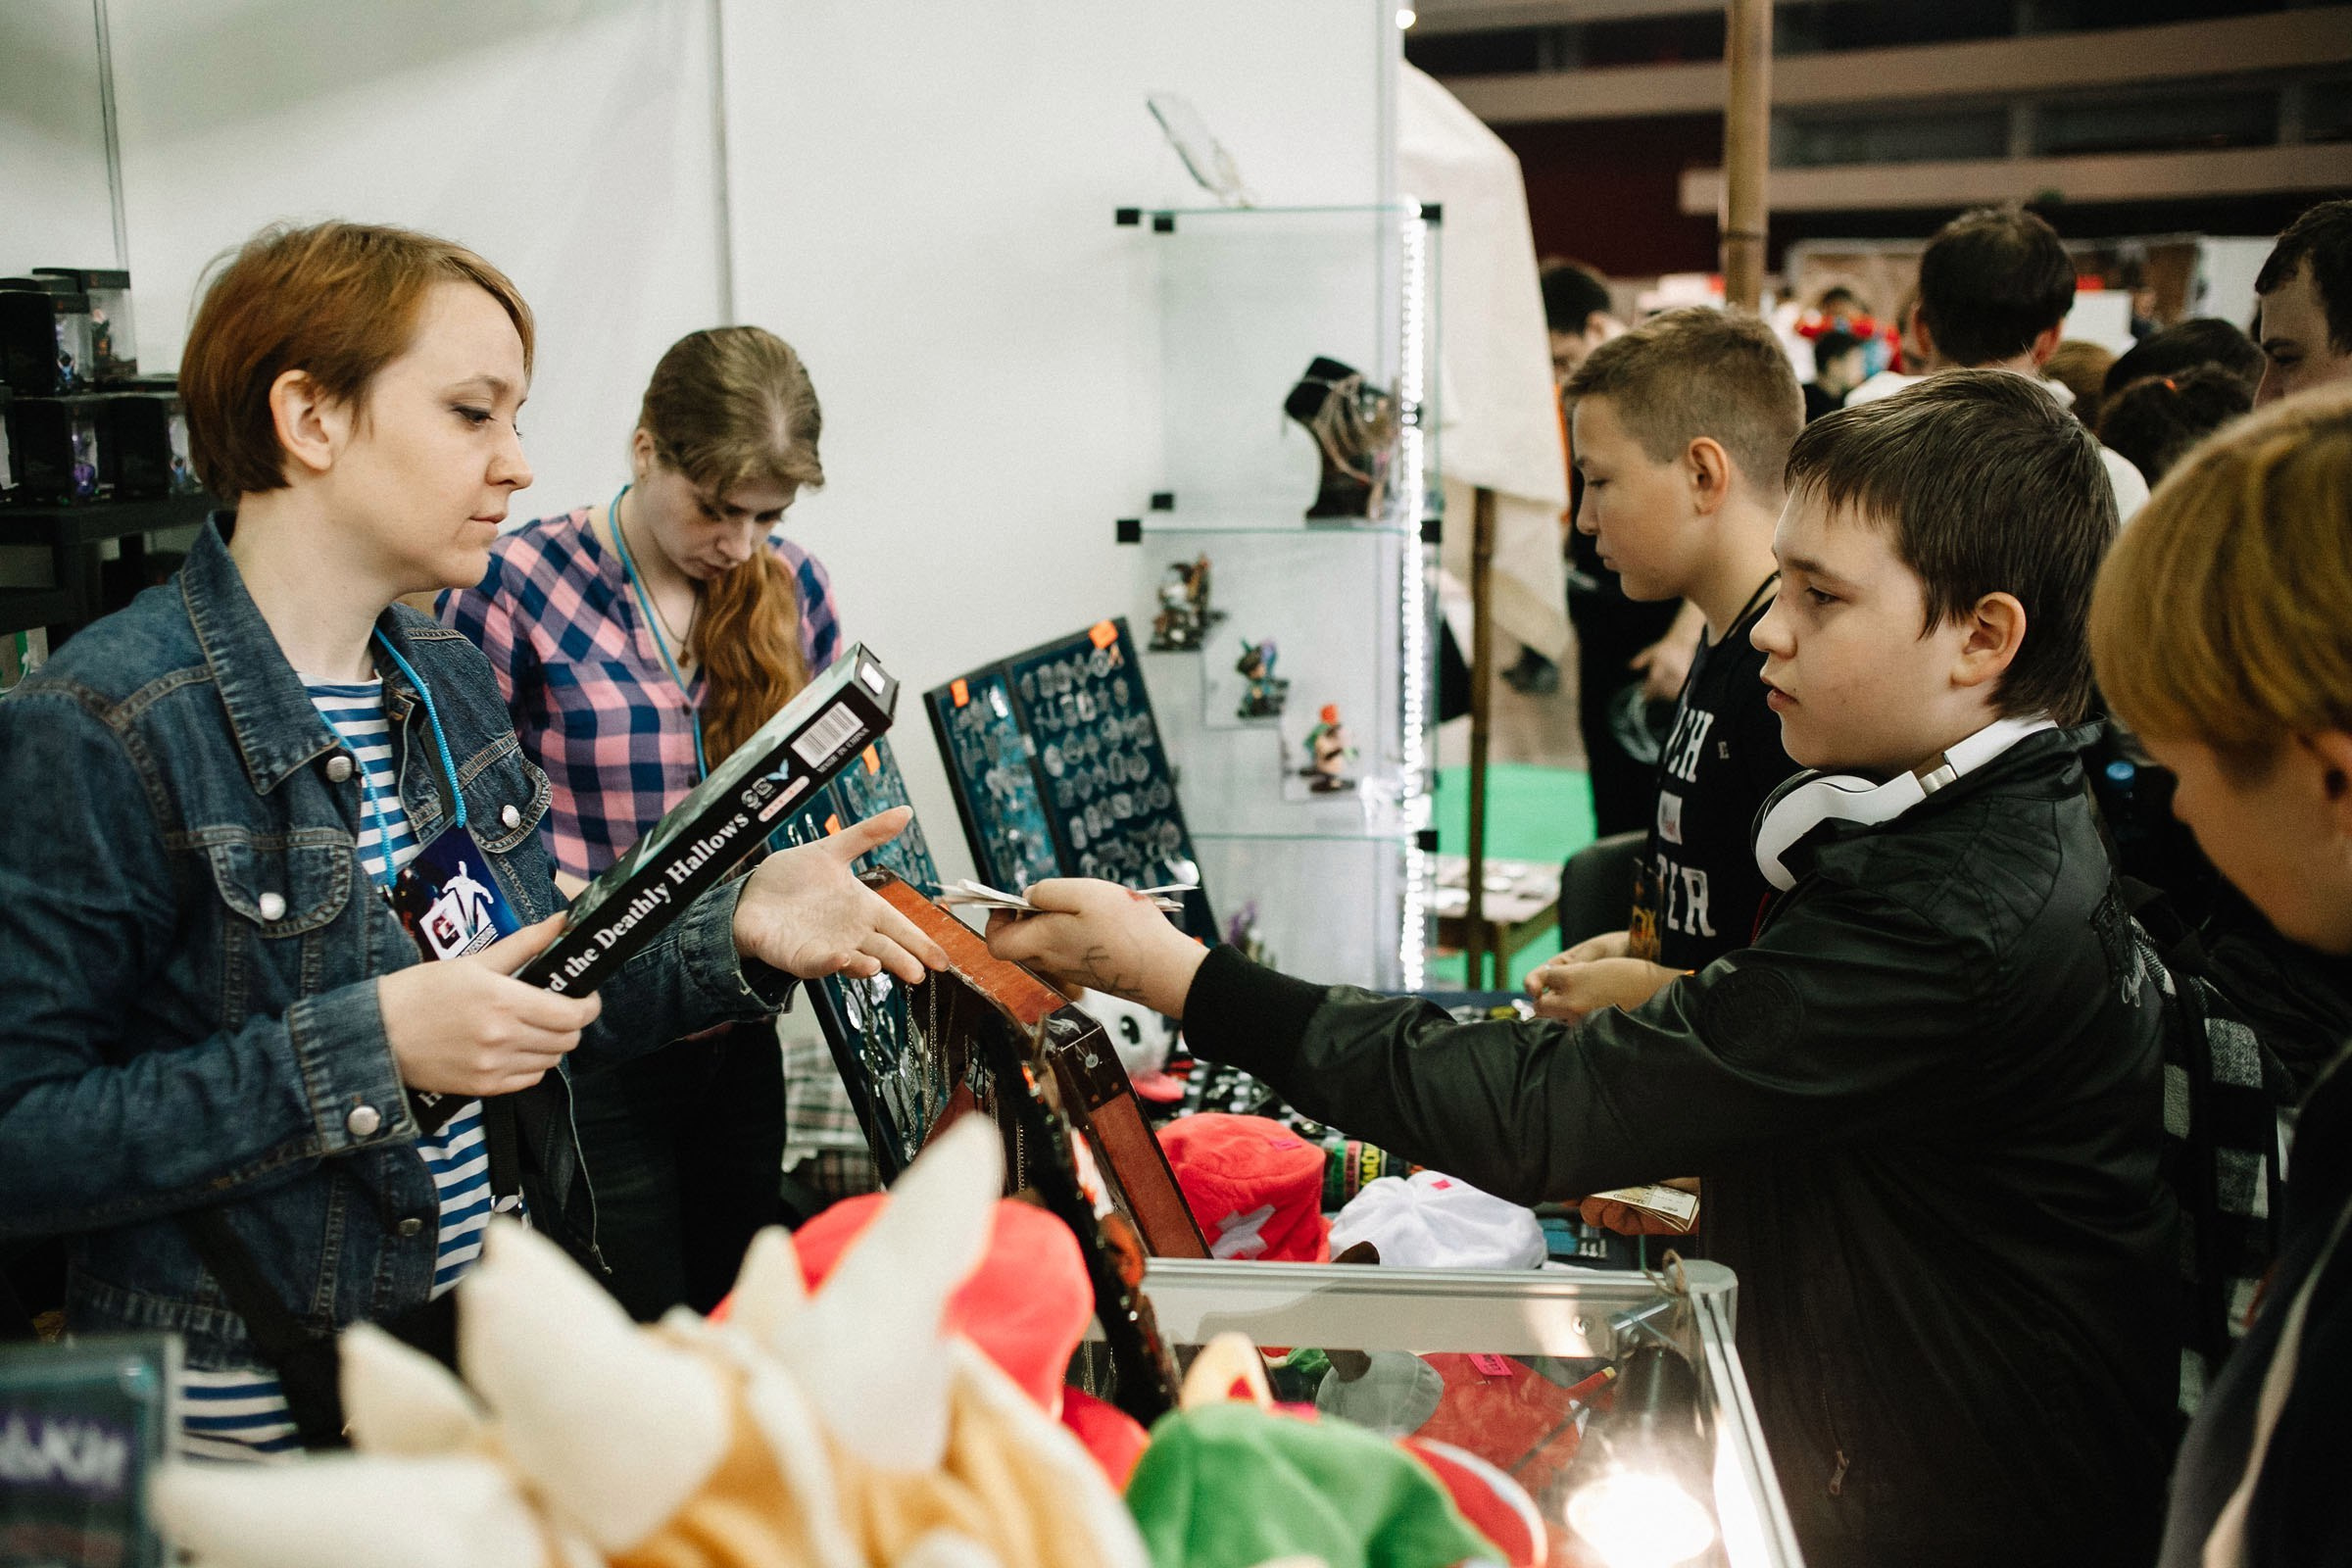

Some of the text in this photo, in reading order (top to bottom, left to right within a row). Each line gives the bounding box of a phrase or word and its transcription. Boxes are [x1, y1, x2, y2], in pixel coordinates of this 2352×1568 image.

[564, 944, 600, 978] the
[593, 877, 672, 950] Deathly
[665, 811, 749, 885] Hallows
